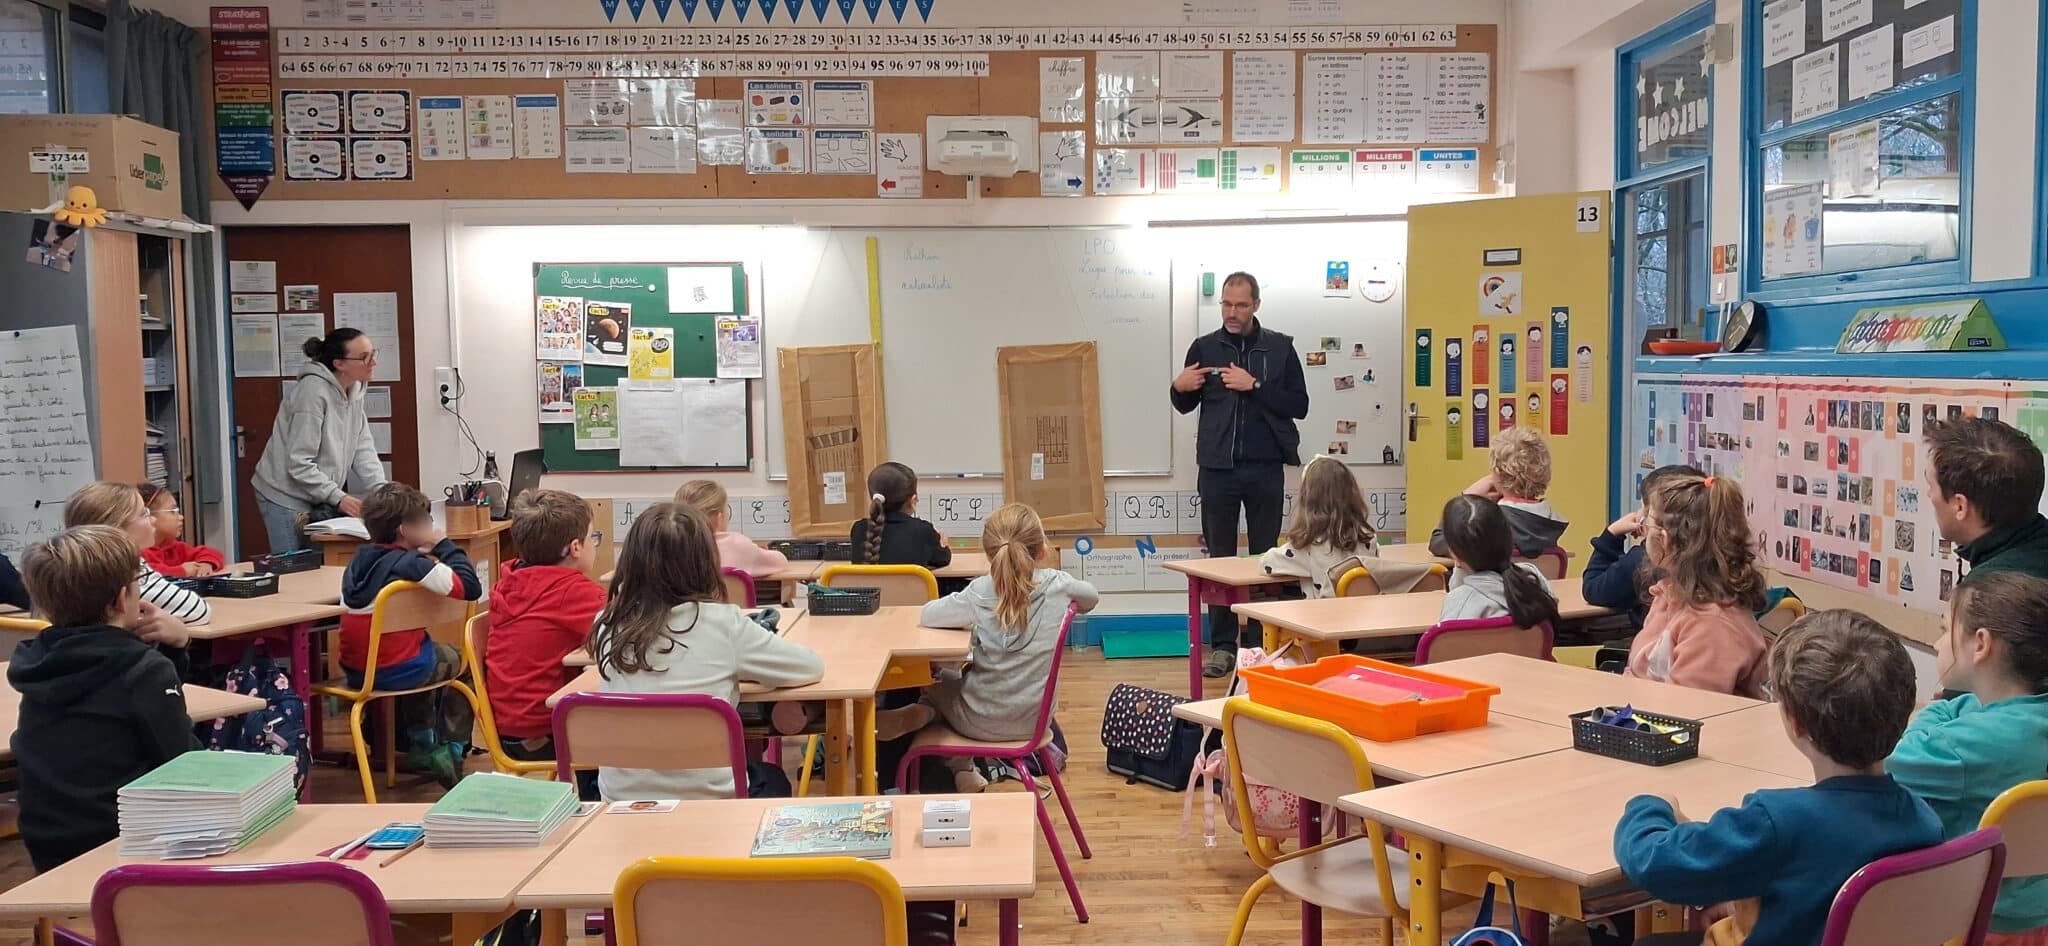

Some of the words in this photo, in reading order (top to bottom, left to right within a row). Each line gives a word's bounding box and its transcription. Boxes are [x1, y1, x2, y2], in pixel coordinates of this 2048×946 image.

[284, 35, 291, 48] 1
[302, 35, 311, 48] 2
[321, 35, 330, 49] 3
[341, 36, 350, 49] 4
[360, 36, 369, 48] 5
[380, 35, 389, 48] 6
[398, 35, 407, 48] 7
[417, 36, 426, 48] 8
[436, 35, 445, 48] 9
[453, 35, 468, 48] 10
[472, 35, 486, 48] 11
[491, 35, 506, 47] 12
[510, 35, 524, 47] 13
[529, 35, 543, 47] 14
[548, 35, 562, 47] 15
[567, 35, 581, 47] 16
[586, 35, 600, 47] 17
[604, 34, 619, 46] 18
[623, 34, 638, 46] 19
[642, 34, 657, 46] 20
[660, 34, 674, 46] 21
[679, 34, 694, 46] 22
[698, 34, 713, 46] 23
[717, 34, 731, 45] 24
[735, 34, 750, 46] 25
[754, 34, 769, 46] 26
[773, 34, 788, 46] 27
[792, 34, 807, 46] 28
[810, 34, 826, 46] 29
[829, 34, 844, 46] 30
[848, 34, 862, 46] 31
[867, 34, 882, 46] 32
[885, 34, 900, 46] 33
[904, 34, 919, 46] 34
[922, 34, 937, 46] 35
[941, 34, 956, 46] 36
[959, 34, 974, 46] 37
[978, 34, 993, 46] 38
[997, 33, 1011, 46] 39
[1015, 33, 1031, 45] 40
[1034, 33, 1047, 45] 41
[1051, 33, 1067, 44] 42
[1070, 33, 1085, 44] 43
[1088, 33, 1104, 44] 44
[1107, 32, 1122, 45] 45
[1125, 33, 1141, 44] 46
[1144, 33, 1159, 44] 47
[1162, 33, 1178, 44] 48
[1181, 33, 1196, 44] 49
[1200, 32, 1215, 44] 50
[1218, 32, 1232, 44] 51
[1236, 32, 1251, 44] 52
[1255, 32, 1270, 44] 53
[1273, 32, 1288, 44] 54
[1292, 32, 1307, 44] 55
[1310, 32, 1325, 44] 56
[1329, 31, 1344, 43] 57
[1348, 31, 1363, 43] 58
[1365, 31, 1381, 43] 59
[1384, 31, 1399, 42] 60
[1403, 31, 1417, 42] 61
[1421, 30, 1436, 42] 62
[1439, 30, 1454, 42] 63
[281, 60, 296, 74] 64
[300, 60, 316, 73] 65
[319, 59, 335, 73] 66
[339, 61, 353, 73] 67
[358, 60, 373, 73] 68
[377, 61, 392, 73] 69
[396, 61, 412, 73] 70
[415, 61, 430, 73] 71
[434, 61, 449, 73] 72
[454, 61, 469, 73] 73
[472, 61, 487, 73] 74
[491, 60, 507, 73] 75
[511, 61, 526, 73] 76
[529, 61, 545, 73] 77
[549, 61, 564, 73] 78
[568, 60, 584, 73] 79
[586, 60, 602, 72] 80
[662, 59, 677, 71] 84
[700, 59, 715, 71] 86
[719, 59, 734, 71] 87
[738, 60, 753, 71] 88
[756, 60, 772, 71] 89
[775, 60, 791, 71] 90
[795, 60, 809, 71] 91
[813, 60, 828, 71] 92
[832, 60, 847, 71] 93
[851, 60, 866, 71] 94
[870, 59, 885, 71] 95
[889, 60, 904, 71] 96
[907, 59, 922, 71] 97
[926, 60, 941, 71] 98
[944, 60, 960, 70] 99
[965, 60, 986, 71] 100
[50, 153, 86, 162] 37344
[1302, 153, 1341, 162] MILLIONS
[1365, 152, 1403, 161] MILLIERS
[1400, 163, 1406, 171] U
[1577, 206, 1599, 222] 13
[561, 270, 589, 285] Revue
[593, 273, 602, 285] de
[610, 274, 640, 290] presse
[620, 503, 635, 525] A
[1124, 496, 1142, 519] Q
[1149, 496, 1171, 519] R
[1370, 492, 1391, 530] Y
[1135, 535, 1157, 558] N
[1086, 553, 1133, 562] Orthographe
[1147, 553, 1162, 561] Non
[1163, 553, 1190, 561] présent
